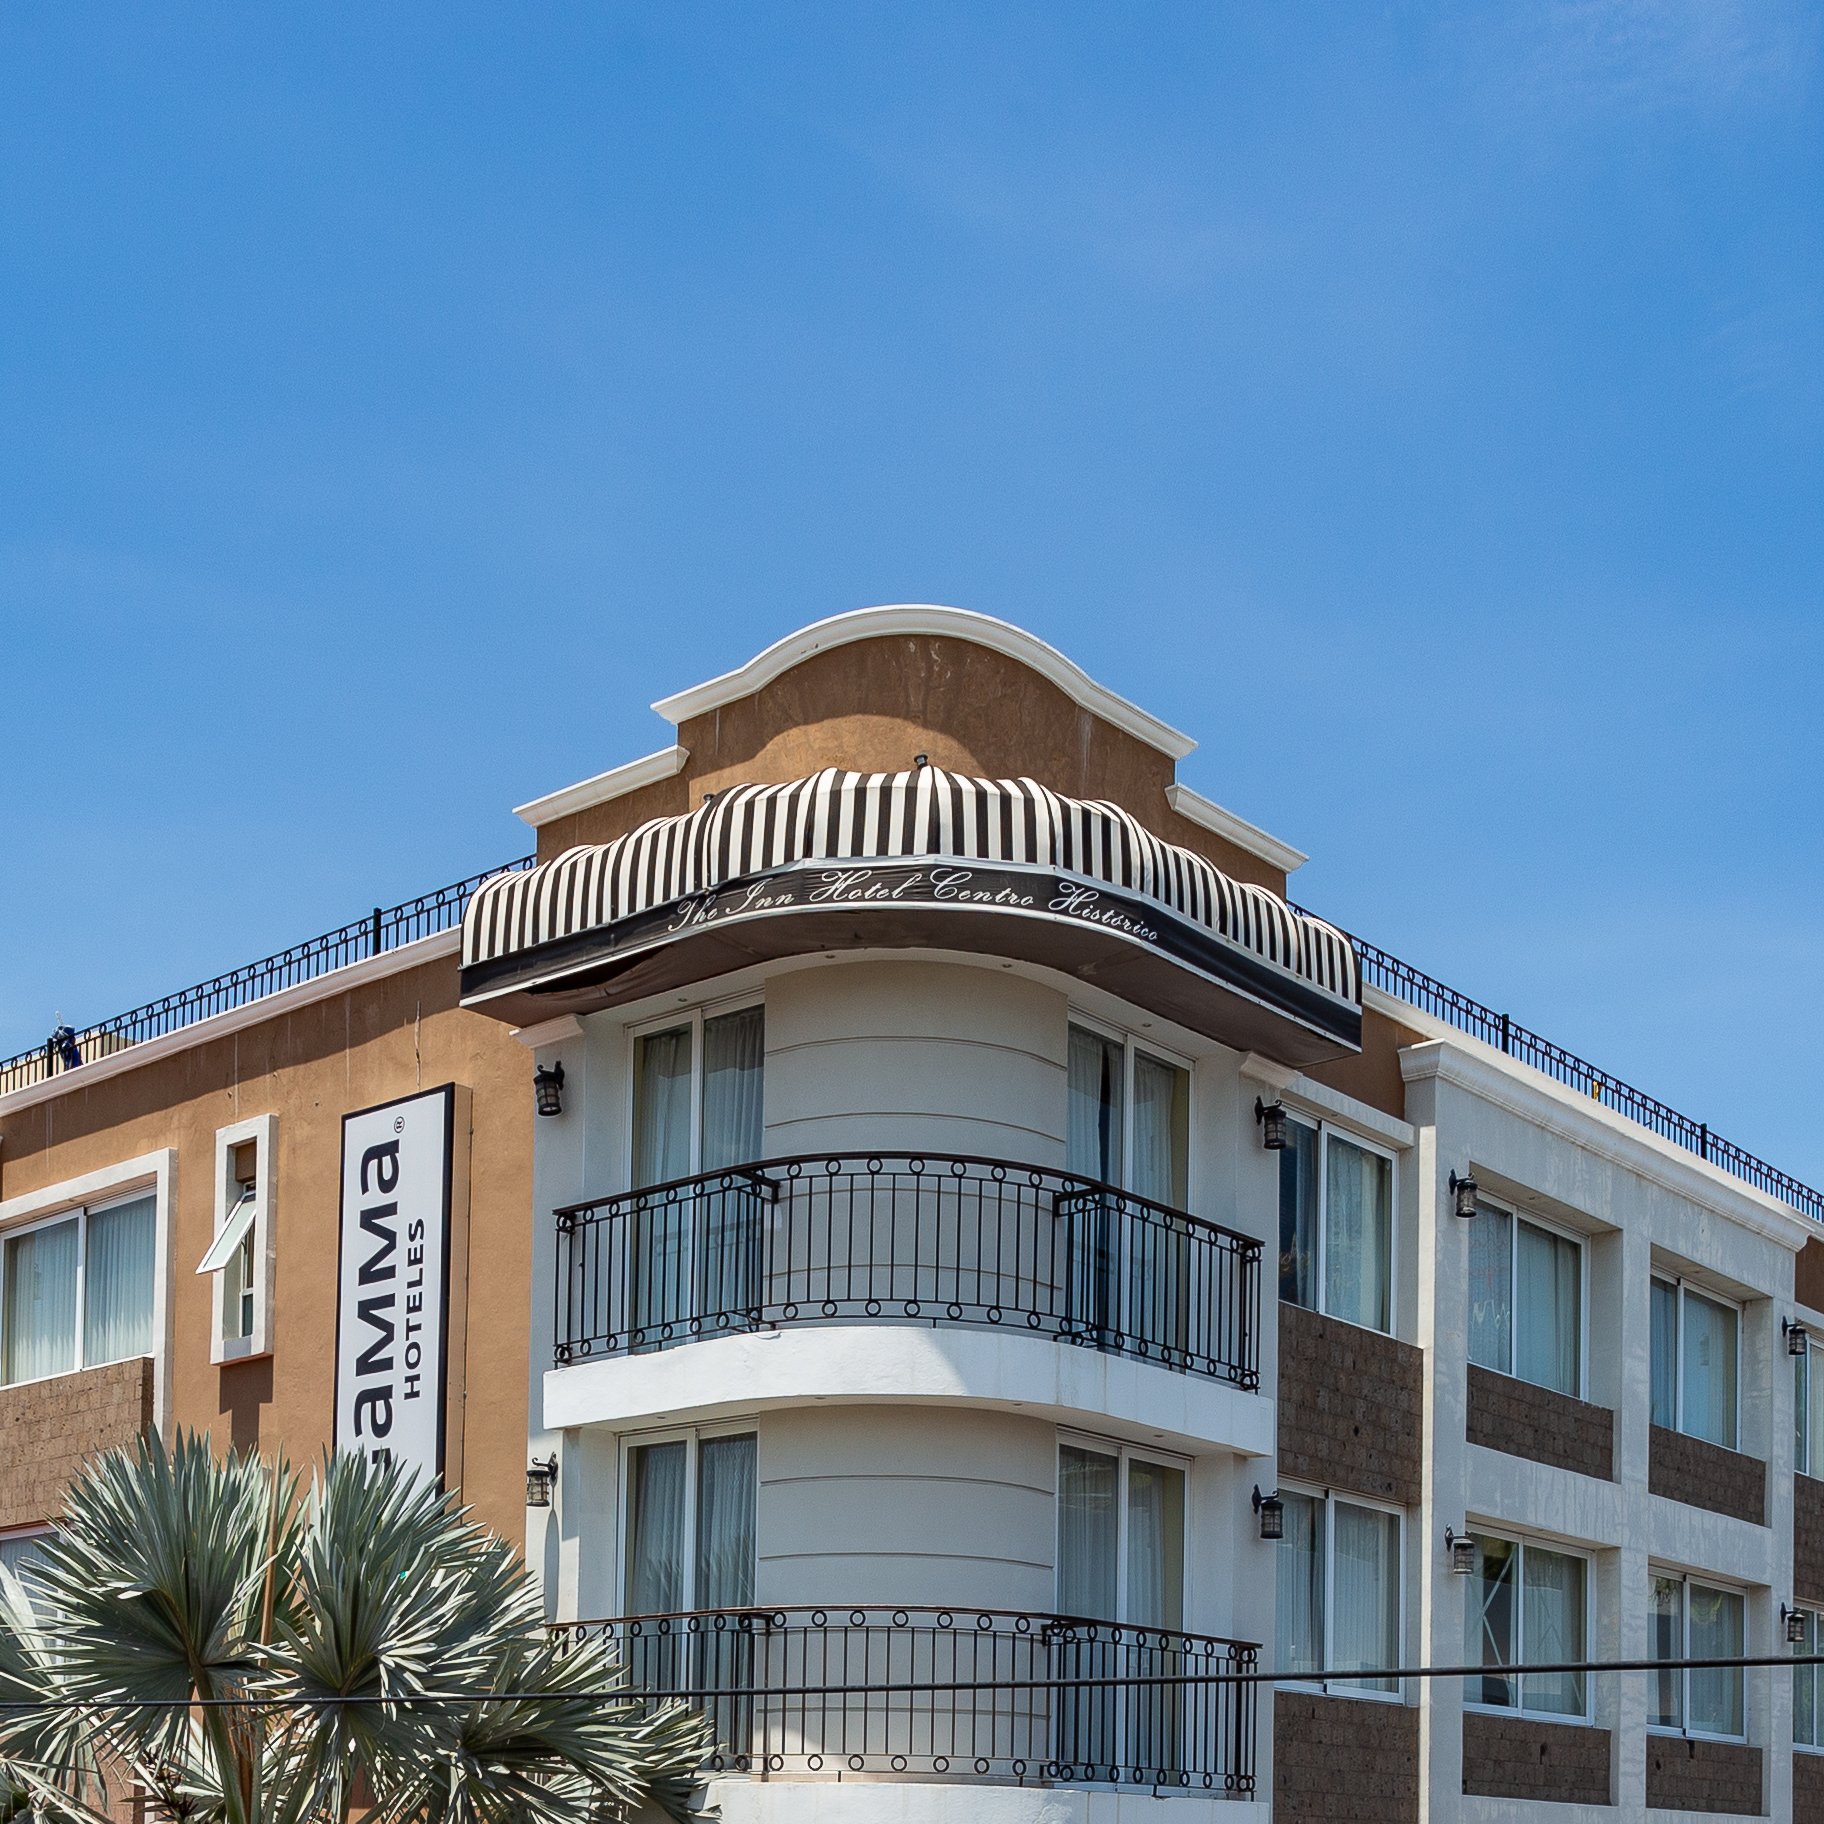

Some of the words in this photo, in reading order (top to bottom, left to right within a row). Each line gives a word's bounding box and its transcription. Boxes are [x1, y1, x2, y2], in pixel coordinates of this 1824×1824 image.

[667, 893, 717, 932] The
[726, 878, 794, 914] Inn
[809, 869, 923, 902] Hotel
[929, 868, 1034, 906] Centro
[403, 1217, 426, 1401] HOTELES
